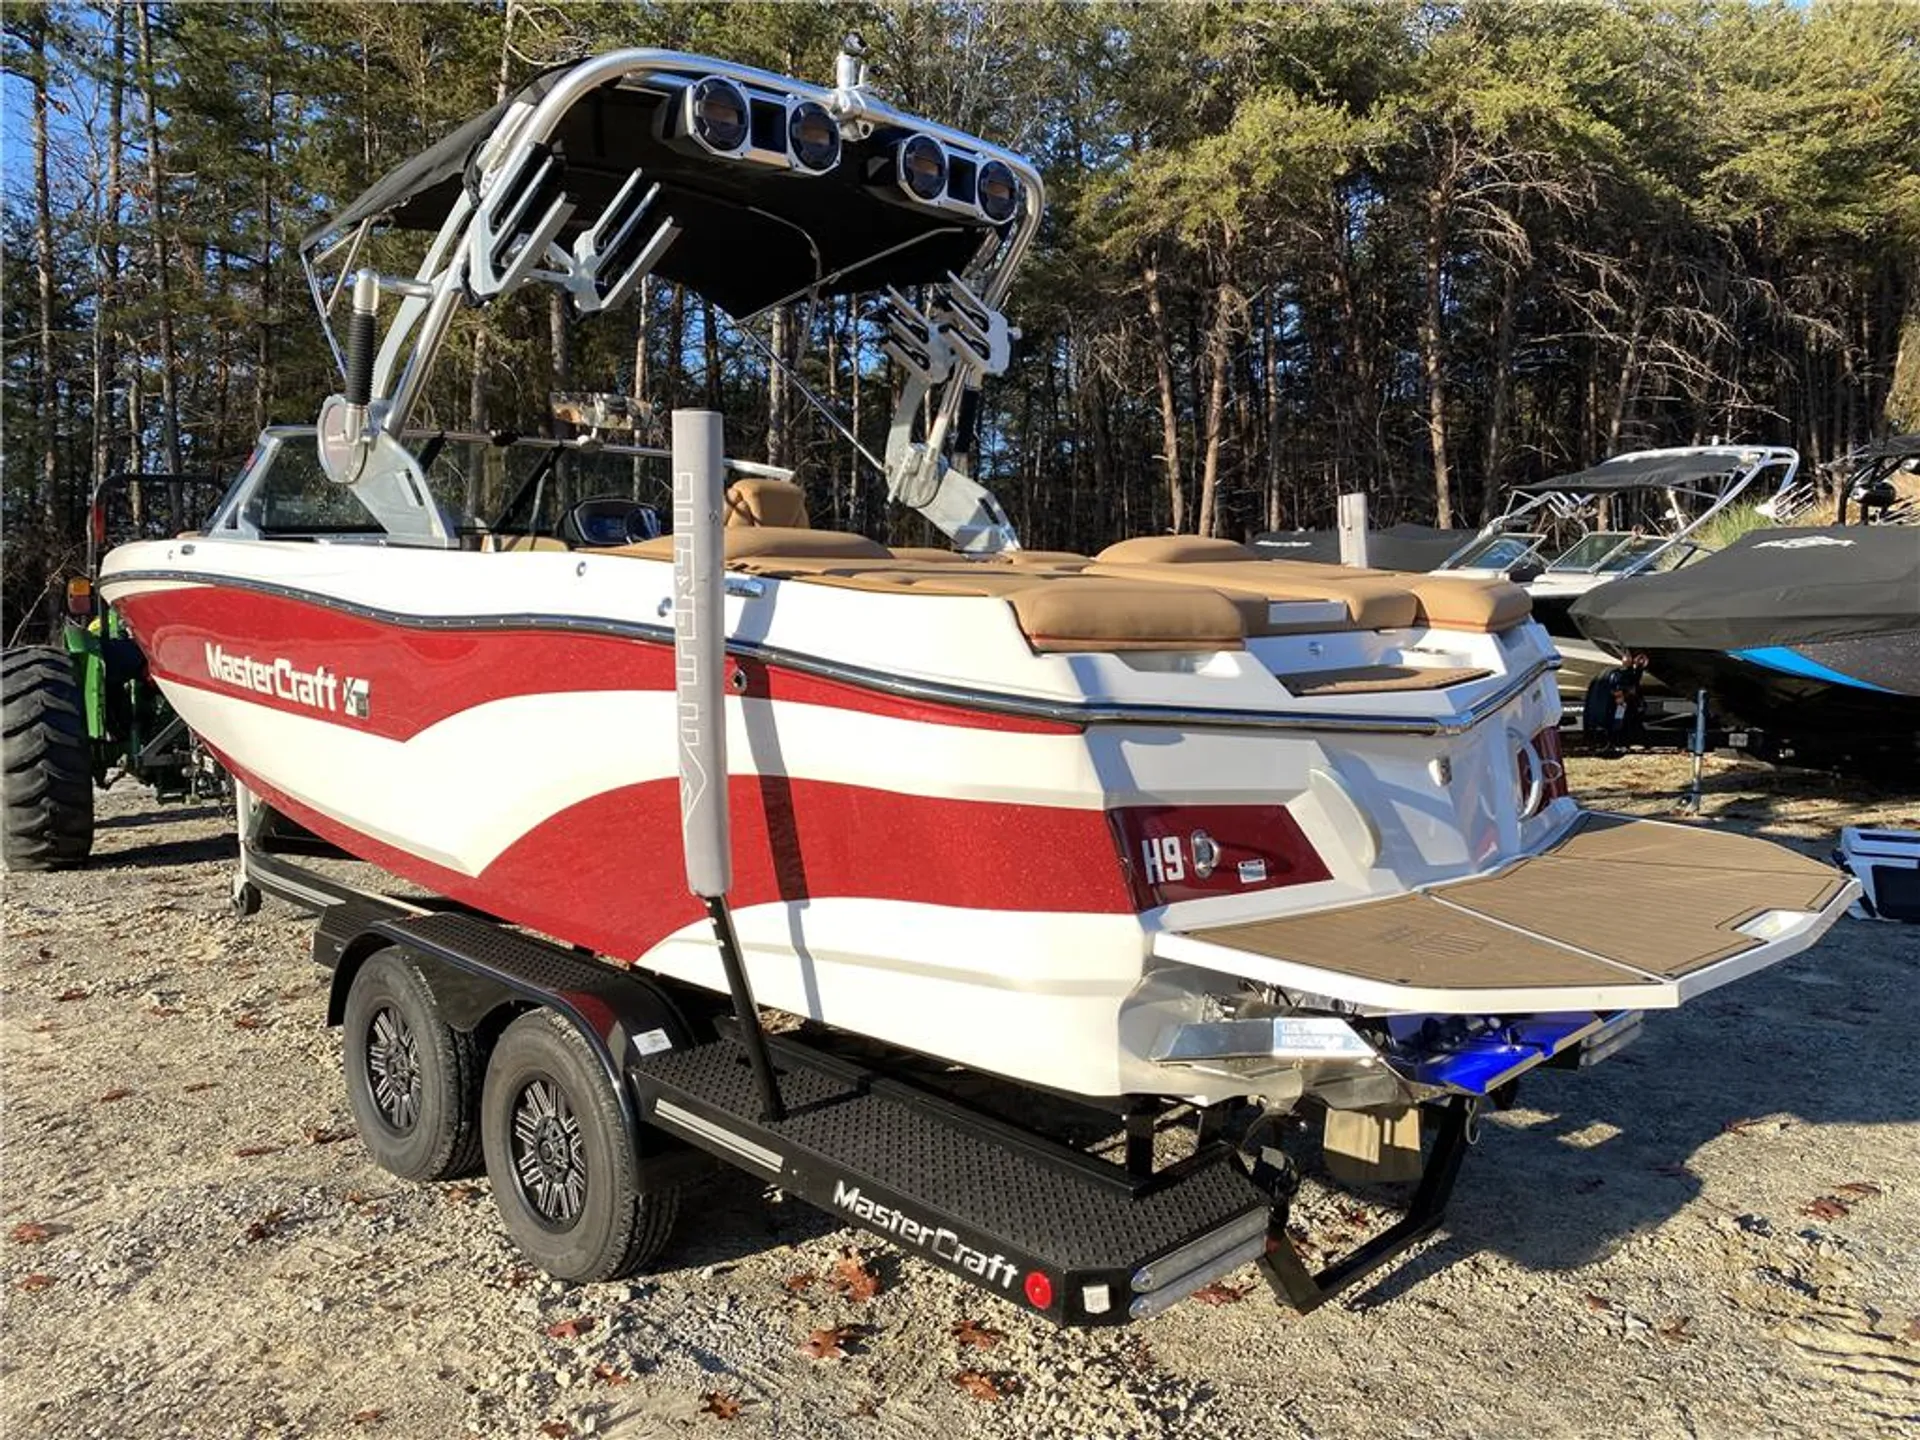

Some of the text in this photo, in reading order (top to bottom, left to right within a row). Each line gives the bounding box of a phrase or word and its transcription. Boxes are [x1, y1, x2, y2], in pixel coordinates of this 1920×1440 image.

[204, 641, 338, 712] MasterCraft
[1141, 835, 1185, 885] H9
[833, 1179, 1019, 1290] MasterCraft
